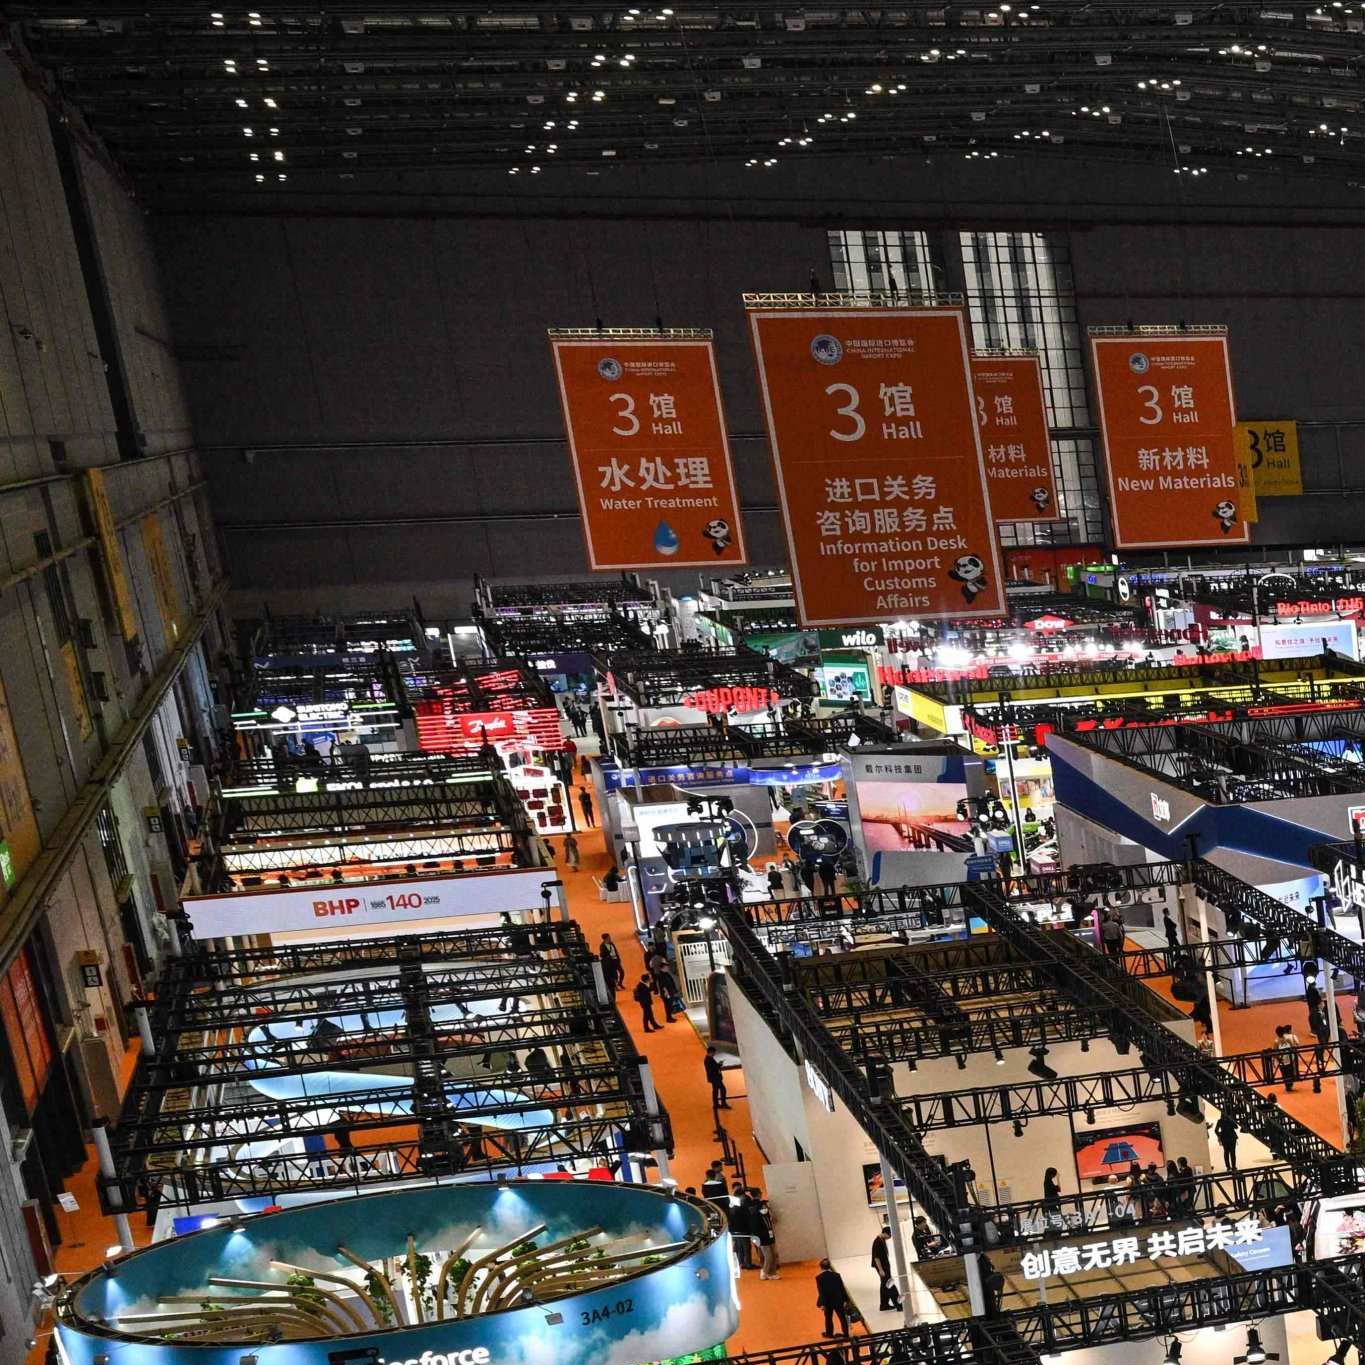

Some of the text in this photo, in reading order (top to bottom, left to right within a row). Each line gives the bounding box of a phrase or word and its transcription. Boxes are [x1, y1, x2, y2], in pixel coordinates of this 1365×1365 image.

[609, 393, 677, 436] 3 馆
[824, 382, 916, 442] 3 馆
[994, 395, 1014, 414] 馆
[1136, 385, 1194, 424] 3 馆
[995, 415, 1018, 426] Hall
[1173, 411, 1199, 424] Hall
[652, 421, 683, 435] Hall
[882, 421, 923, 439] Hall
[1264, 429, 1287, 453] 馆
[1138, 446, 1210, 471] 新材料
[1266, 458, 1291, 470] Hall
[597, 457, 714, 494] 水处理
[1118, 477, 1154, 491] New
[1158, 473, 1235, 490] Materials
[824, 474, 937, 503] 进口关务
[600, 496, 718, 510] Water Treatment
[816, 506, 957, 537] 咨询服务点
[820, 535, 968, 556] Information Desk
[853, 555, 941, 575] for Import
[863, 575, 937, 592] Customs
[876, 593, 930, 609] Affairs
[842, 631, 876, 647] wilo
[865, 764, 922, 776] 戴尔科技集团
[313, 899, 361, 917] BHP
[386, 893, 422, 910] 140
[1020, 1218, 1264, 1281] 创意无界 共启未来
[580, 1298, 634, 1326] 3A4-02
